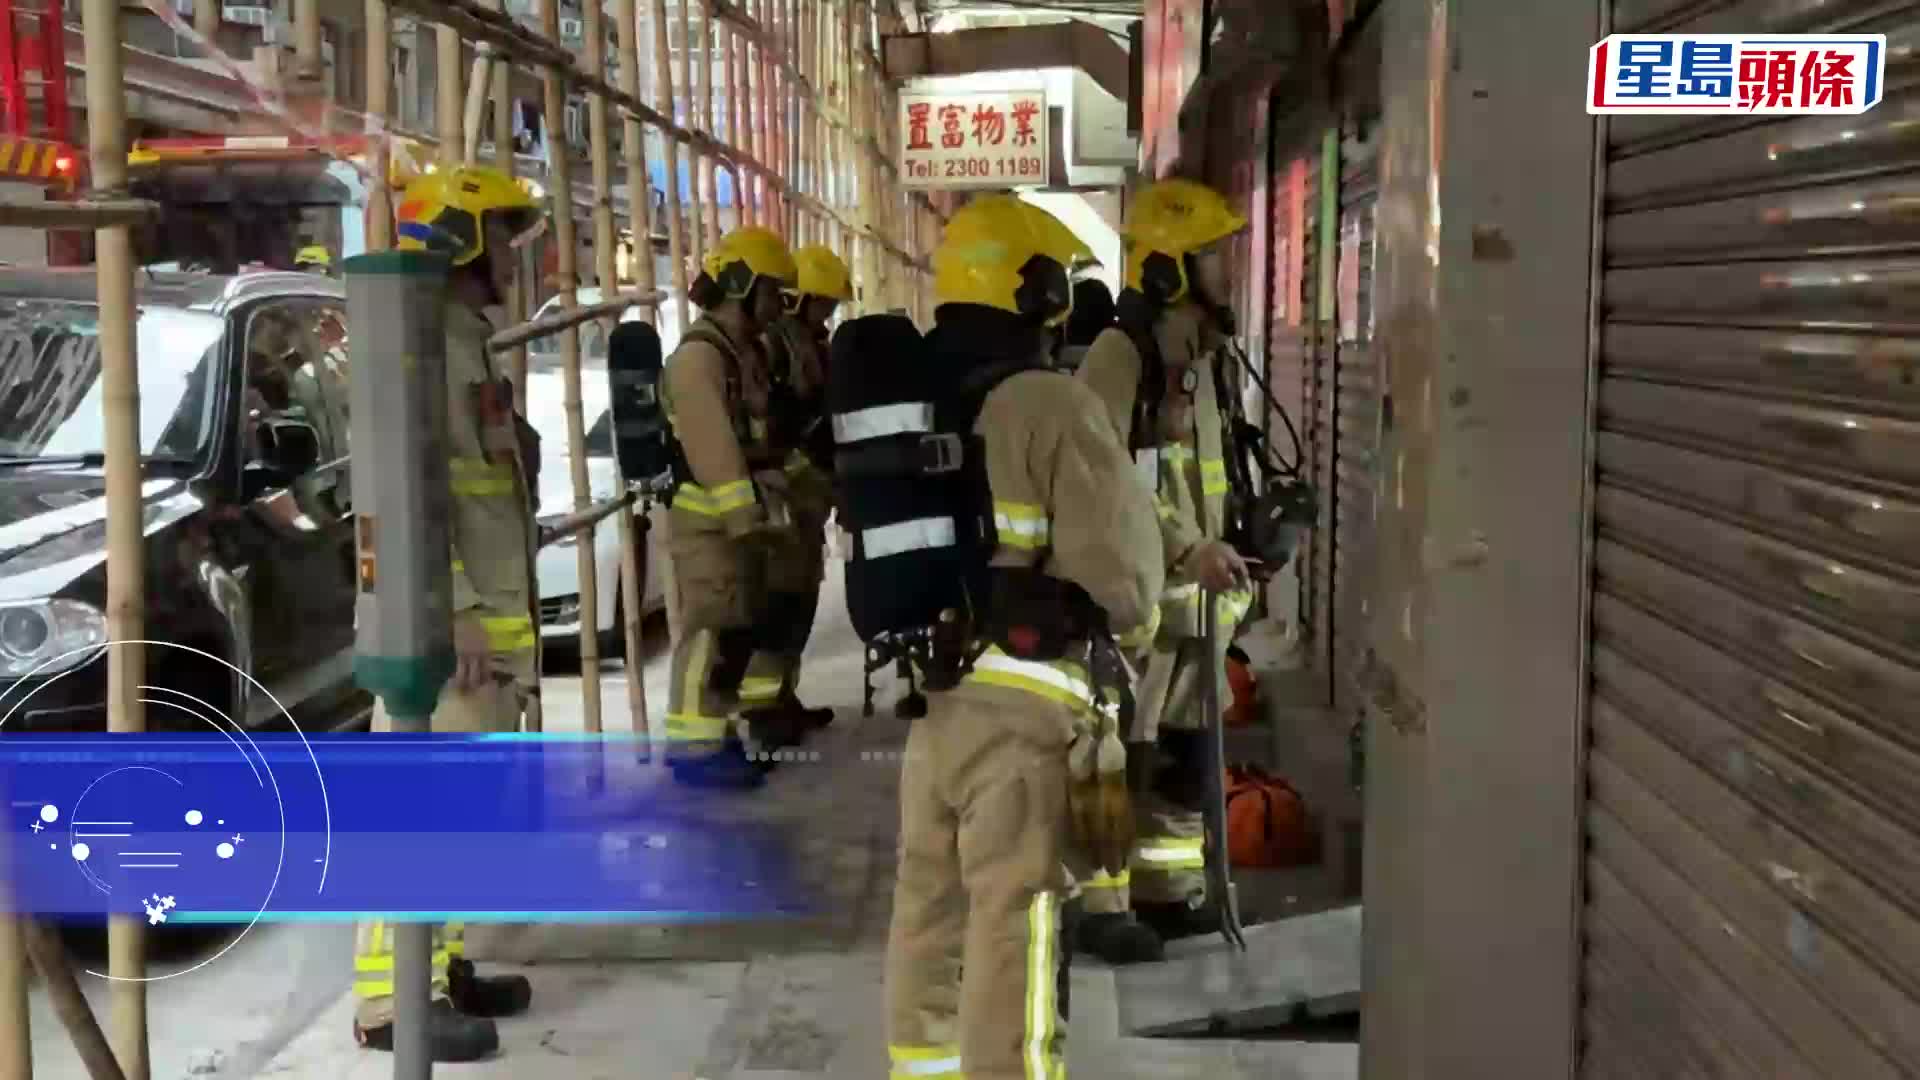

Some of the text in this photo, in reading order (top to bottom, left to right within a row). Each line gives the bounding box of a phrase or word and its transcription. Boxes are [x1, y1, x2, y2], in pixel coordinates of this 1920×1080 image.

[906, 101, 1039, 150] 置富物業
[905, 159, 938, 177] Tel:
[945, 157, 989, 177] 2300
